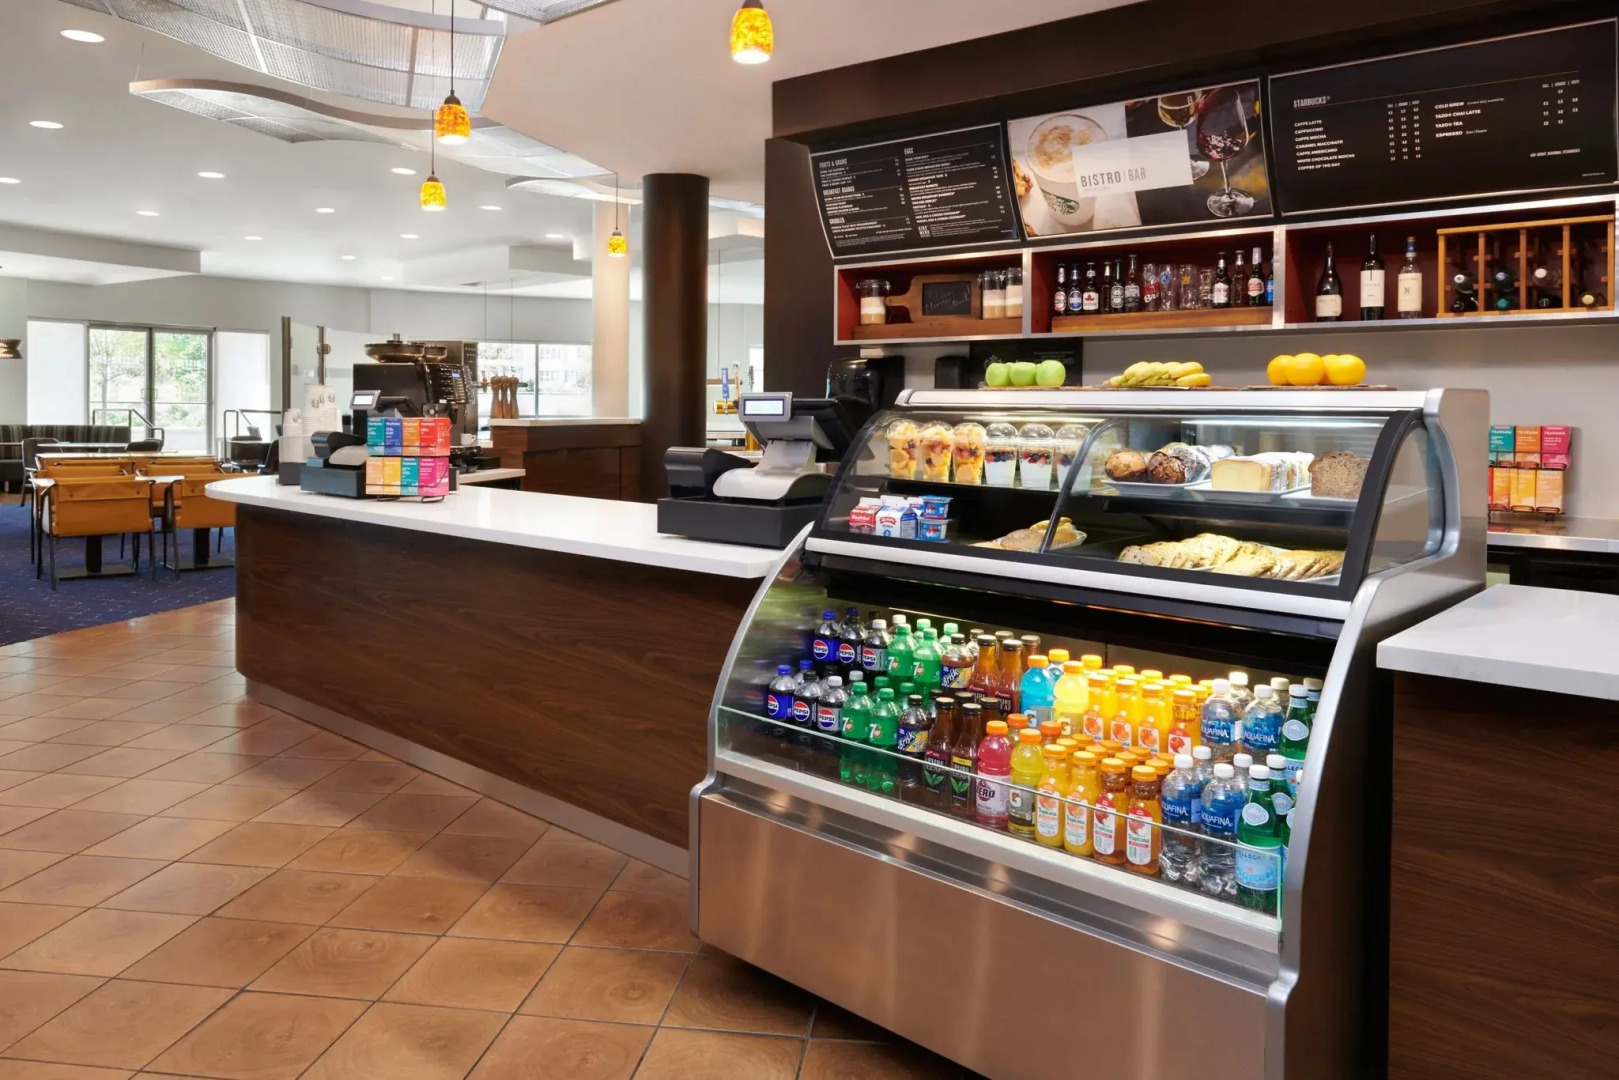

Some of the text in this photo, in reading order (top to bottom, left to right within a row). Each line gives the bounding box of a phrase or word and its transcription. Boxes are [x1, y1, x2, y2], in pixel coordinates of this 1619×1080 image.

[1317, 139, 1344, 147] MACCHIATO
[1081, 167, 1146, 187] BISTRO BAR
[823, 187, 841, 196] BREAKFAST
[1202, 726, 1229, 738] QUAFINA
[1243, 730, 1276, 744] AQUAFINA
[927, 757, 944, 766] PURE
[954, 763, 970, 772] PURE
[976, 786, 995, 798] ZERO
[1038, 807, 1057, 816] Tropicana
[1162, 801, 1189, 816] QUAFINA
[1066, 815, 1085, 825] Tropicana
[1095, 824, 1113, 834] Tropicana
[1128, 834, 1149, 843] Tropicana
